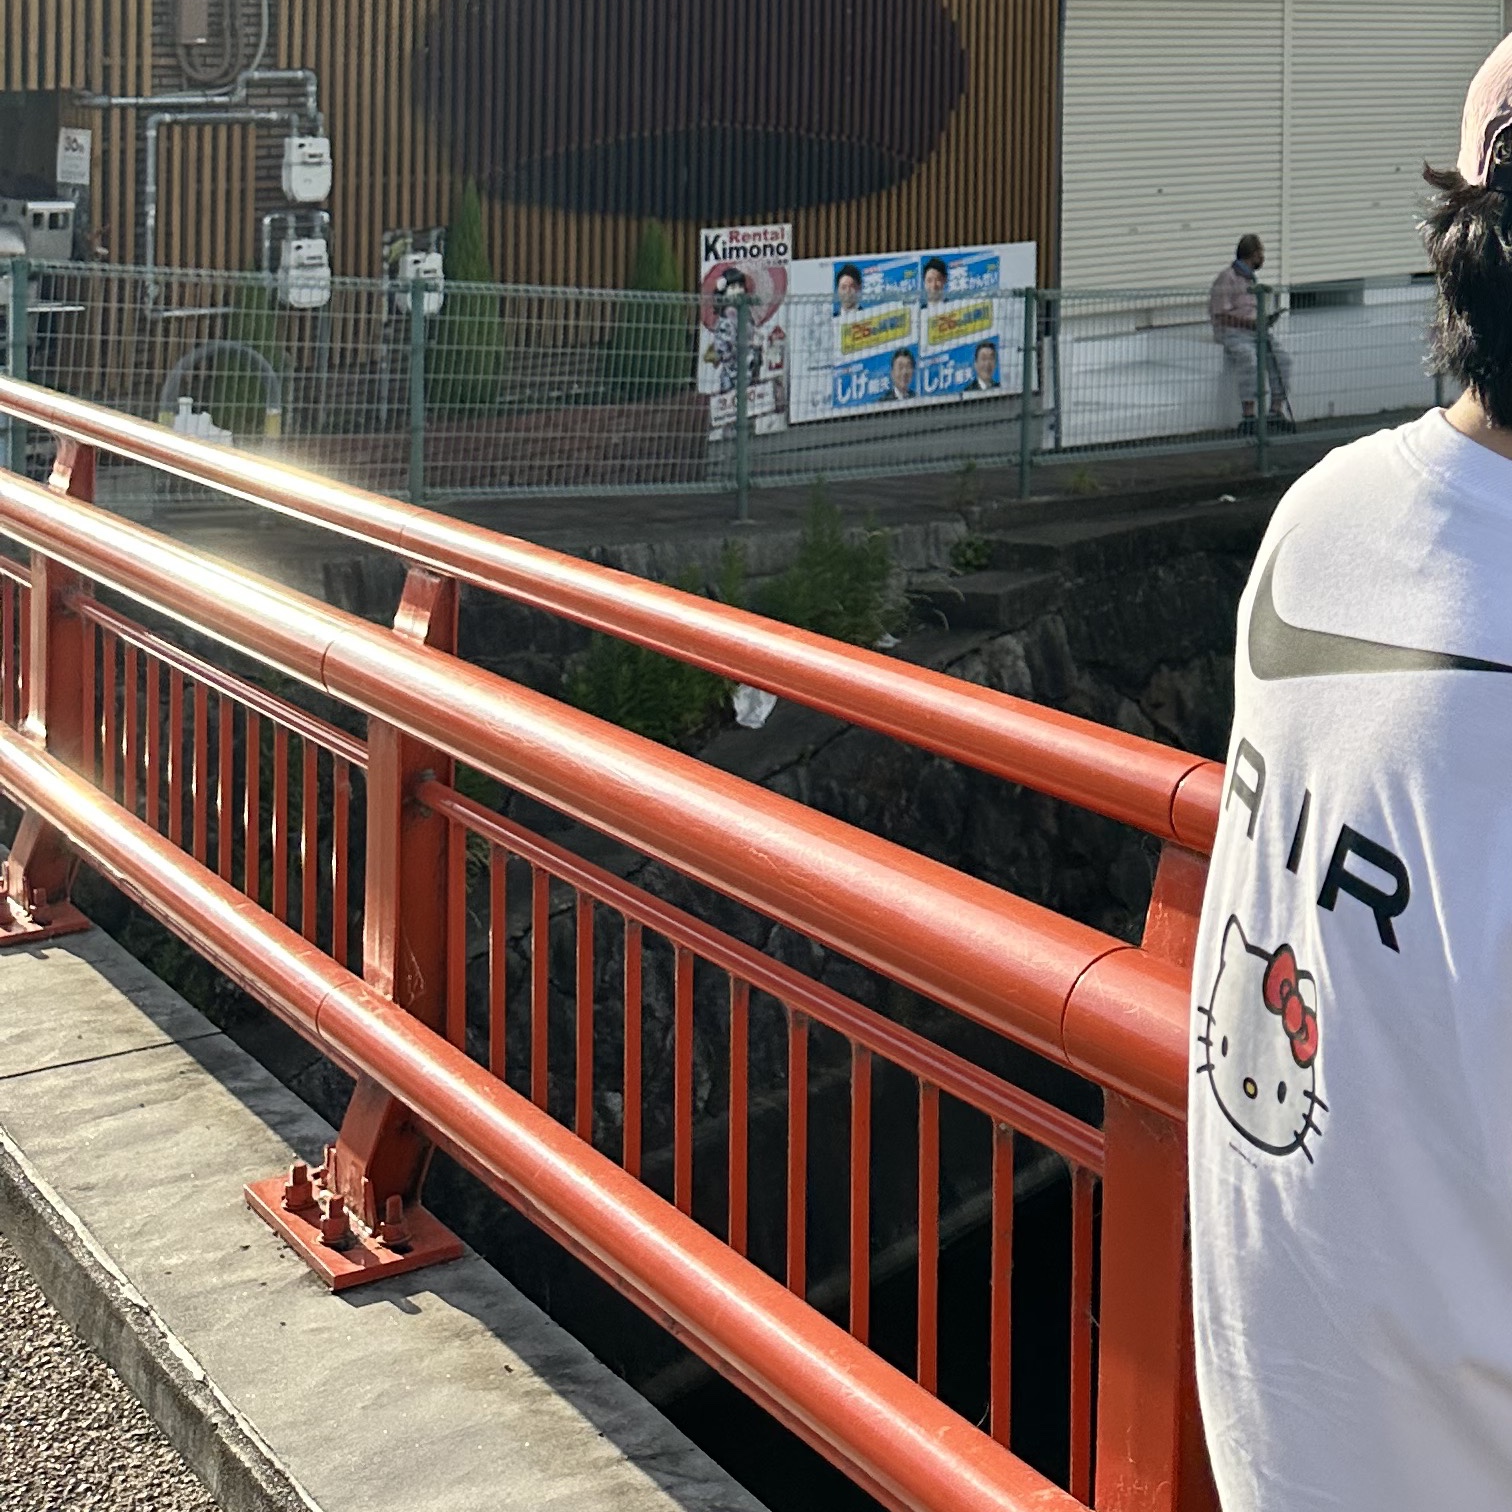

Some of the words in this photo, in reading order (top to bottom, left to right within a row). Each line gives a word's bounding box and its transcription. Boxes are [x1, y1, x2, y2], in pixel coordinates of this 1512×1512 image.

[704, 233, 788, 261] Kimono
[728, 227, 785, 244] Rental
[1226, 737, 1412, 954] AIR
